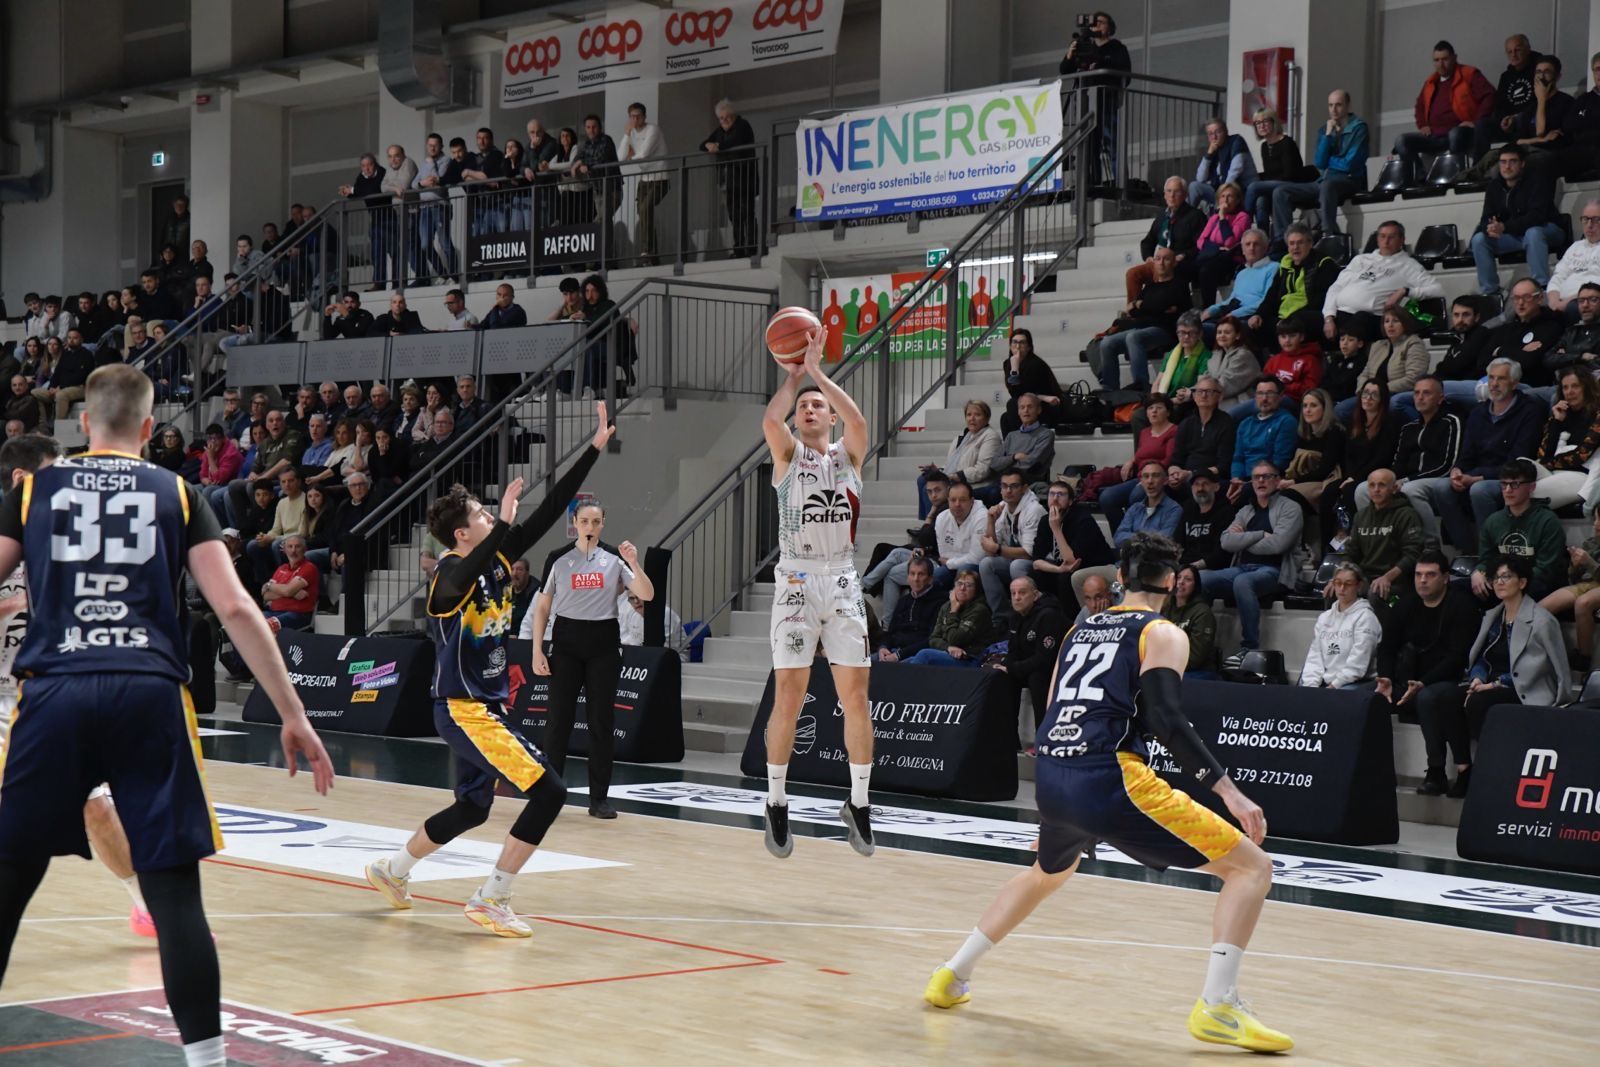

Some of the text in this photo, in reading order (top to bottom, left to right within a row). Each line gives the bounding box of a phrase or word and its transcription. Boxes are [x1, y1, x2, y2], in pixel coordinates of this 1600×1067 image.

[665, 7, 733, 48] coop
[578, 19, 643, 61] coop
[752, 40, 790, 55] Novacoop
[505, 36, 561, 76] coop
[666, 56, 701, 69] Novacoop
[578, 70, 607, 83] Novacoop
[504, 86, 534, 97] Novacoop
[804, 90, 1049, 176] INENERGY
[832, 161, 1016, 195] L'energia sostenibile del tuo territorio
[911, 195, 957, 208] 800.188.569
[481, 233, 596, 260] TRIBUNA PAFFONI
[904, 340, 923, 352] PER
[926, 339, 937, 351] LA
[72, 472, 137, 491] CRESPI
[51, 487, 156, 565] 33
[87, 627, 149, 648] GTS
[1072, 627, 1127, 643] CEPARANO
[351, 664, 371, 673] Grafica
[368, 665, 394, 679] solutions
[1056, 642, 1120, 703] 22
[363, 680, 375, 689] Foto
[380, 676, 397, 686] Video
[534, 684, 549, 692] RIST
[354, 691, 375, 700] Stampa
[615, 689, 639, 700] INITURA
[898, 703, 966, 725] FRITTI
[873, 726, 934, 742] braci & cucina
[1222, 716, 1328, 736] Via Degli Osci, 10
[1217, 732, 1323, 753] DOMODOSSOLA
[819, 748, 831, 759] via
[879, 754, 891, 766] 47
[896, 756, 944, 771] OMEGNA
[1234, 768, 1313, 788] 379 2717108
[1497, 821, 1553, 839] servizi
